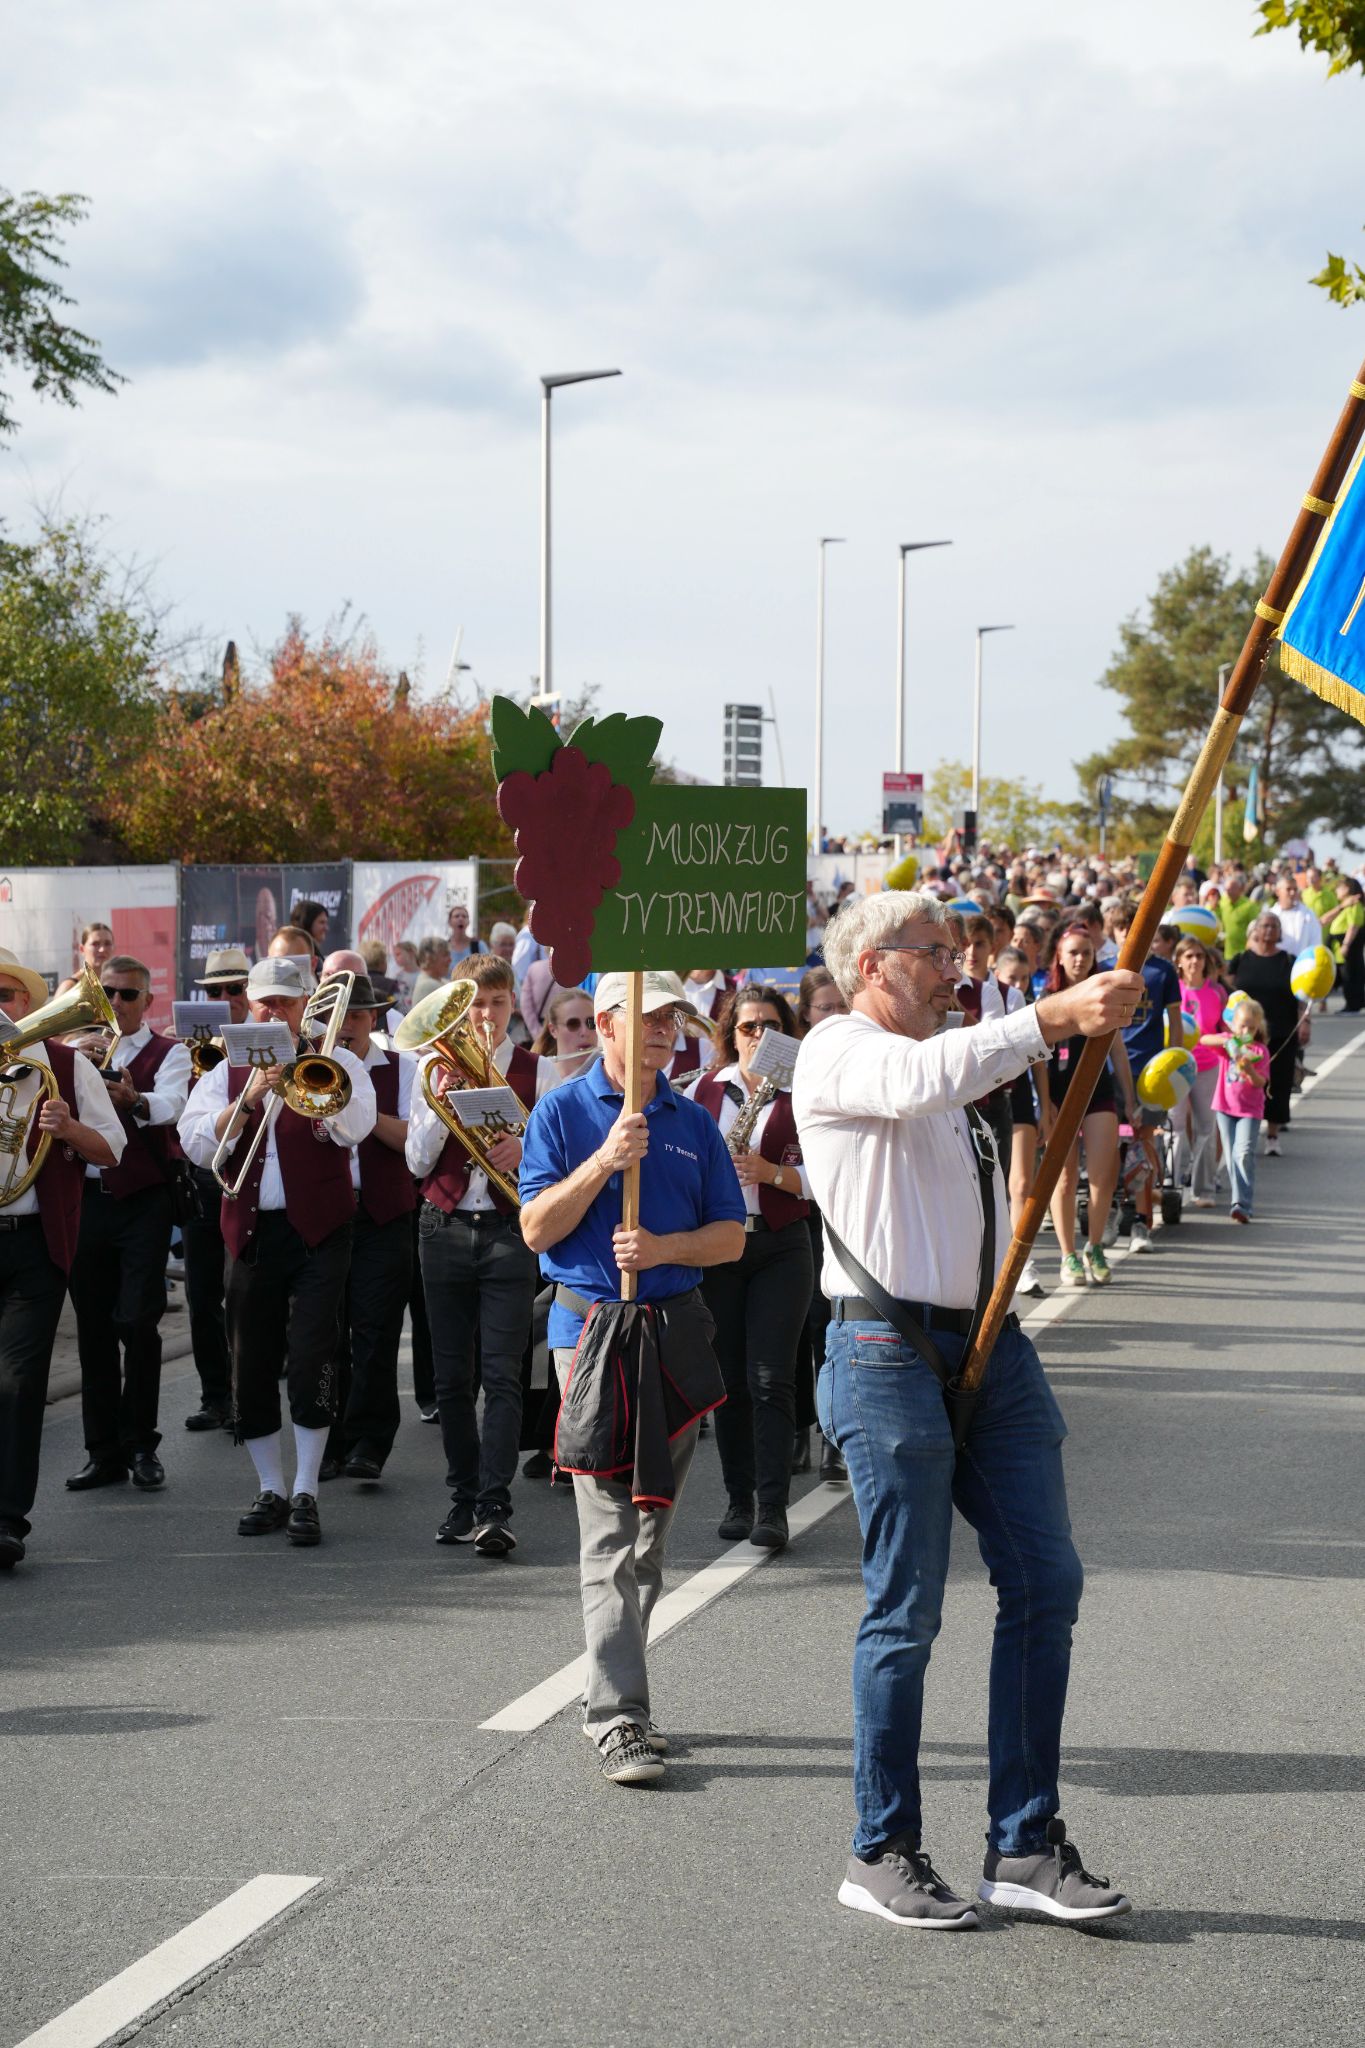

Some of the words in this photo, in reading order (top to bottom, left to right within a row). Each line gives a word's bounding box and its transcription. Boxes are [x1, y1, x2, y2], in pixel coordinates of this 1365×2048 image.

[615, 892, 657, 935] TV
[658, 891, 805, 935] TRENNFURT
[664, 1143, 674, 1152] TV
